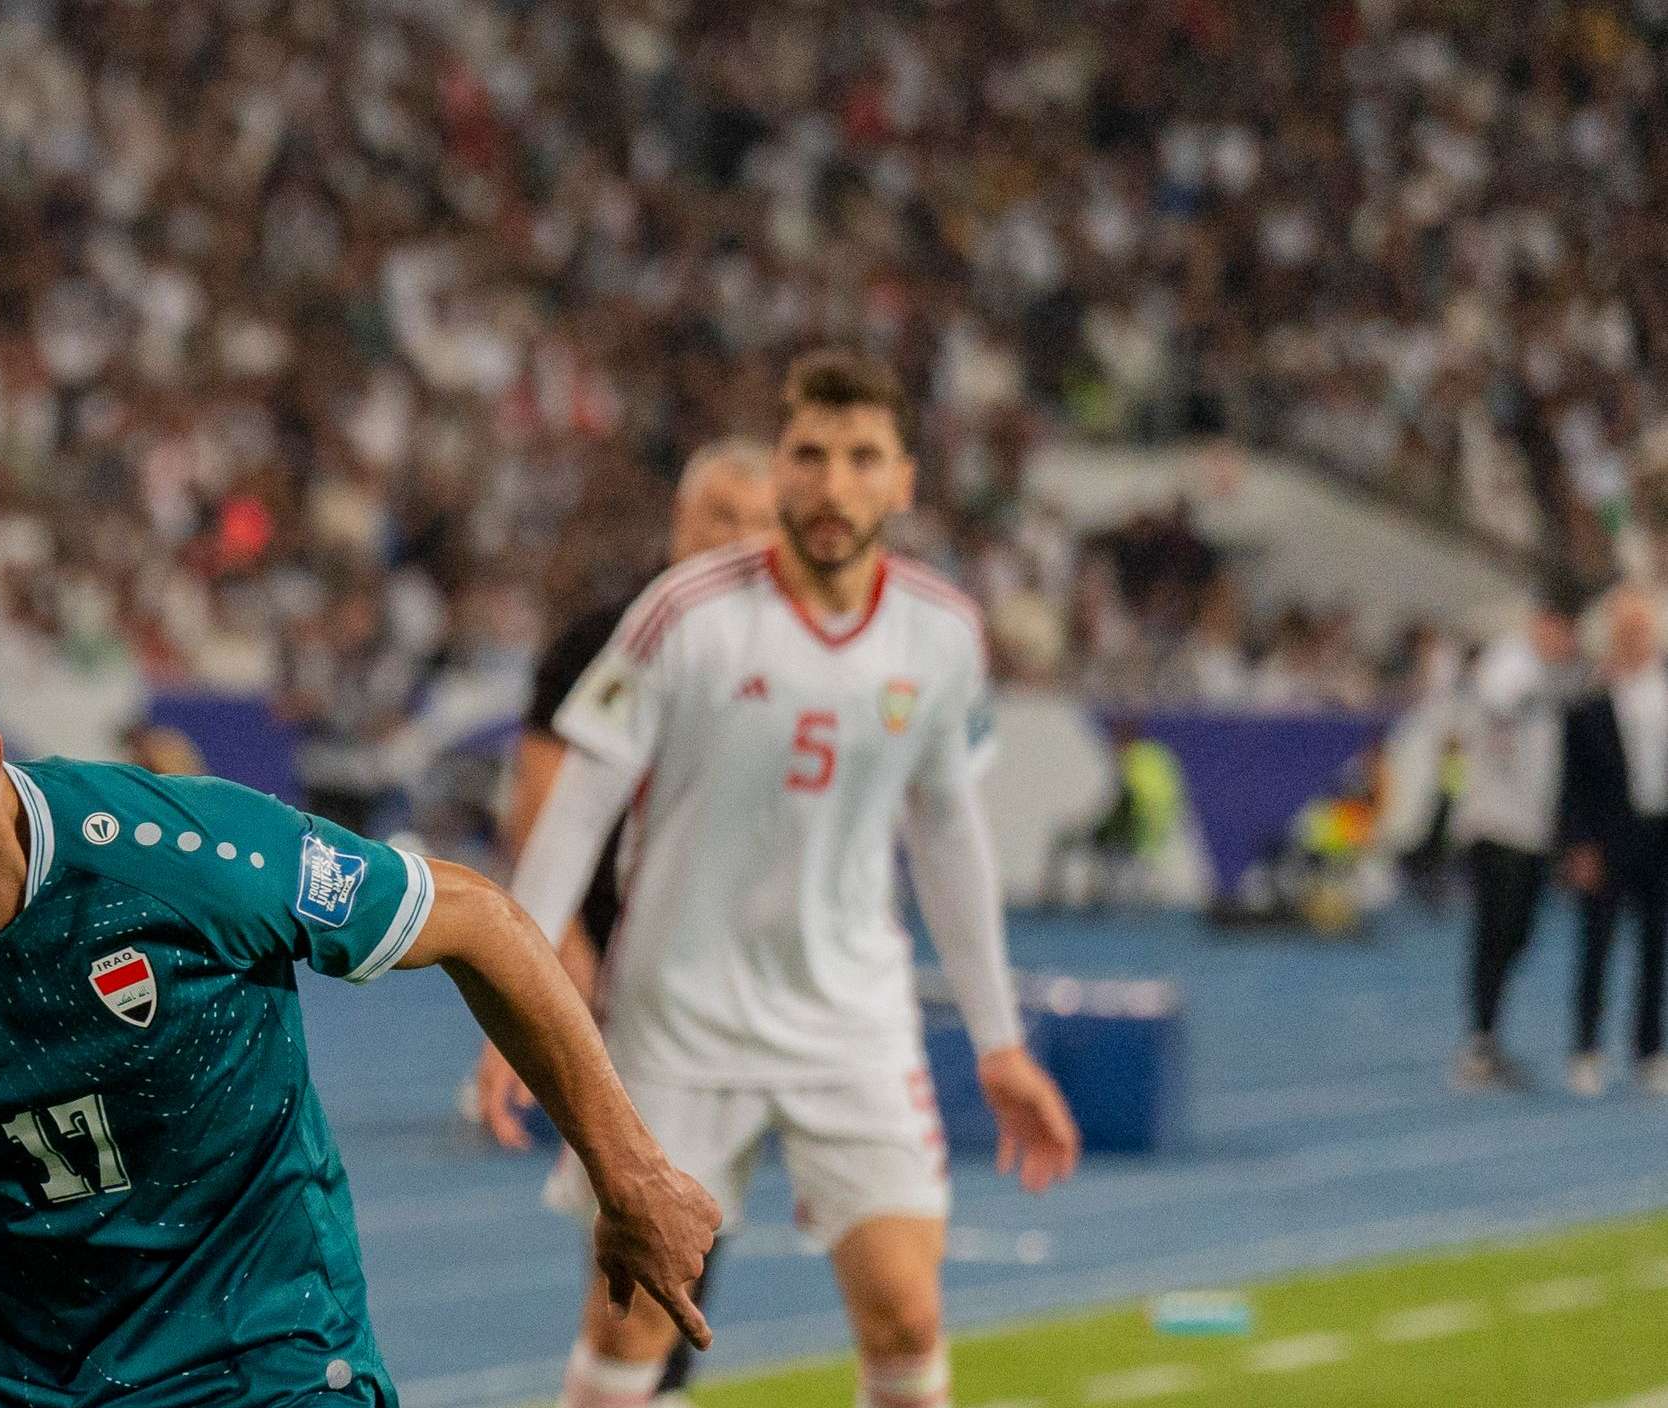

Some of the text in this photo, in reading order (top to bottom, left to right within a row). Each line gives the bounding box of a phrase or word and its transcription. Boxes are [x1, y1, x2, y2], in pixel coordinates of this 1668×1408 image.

[784, 709, 839, 794] 5
[96, 952, 133, 972] IRAQ
[1, 1094, 131, 1203] 17
